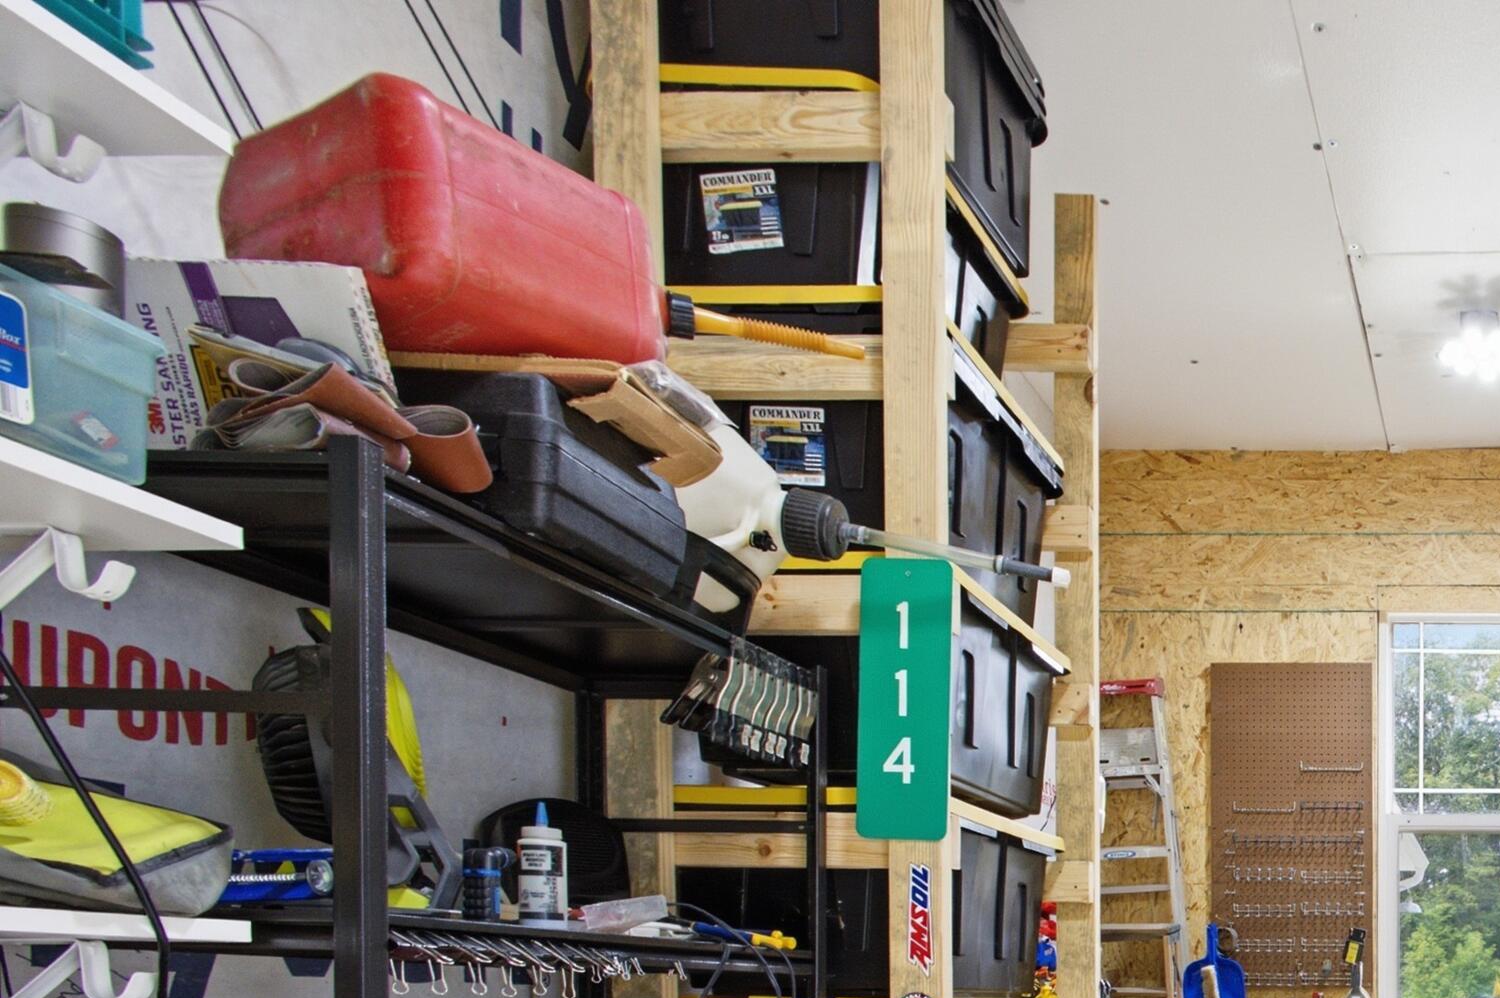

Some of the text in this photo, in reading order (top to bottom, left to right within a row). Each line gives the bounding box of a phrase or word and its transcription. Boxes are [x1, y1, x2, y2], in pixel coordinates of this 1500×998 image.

[703, 171, 773, 187] COMMANDER
[754, 184, 776, 196] XXL
[147, 402, 166, 435] 3M
[752, 407, 821, 420] COMMANDER
[802, 422, 823, 432] XXL
[0, 619, 237, 746] UPONT
[910, 866, 932, 971] AMSOIL
